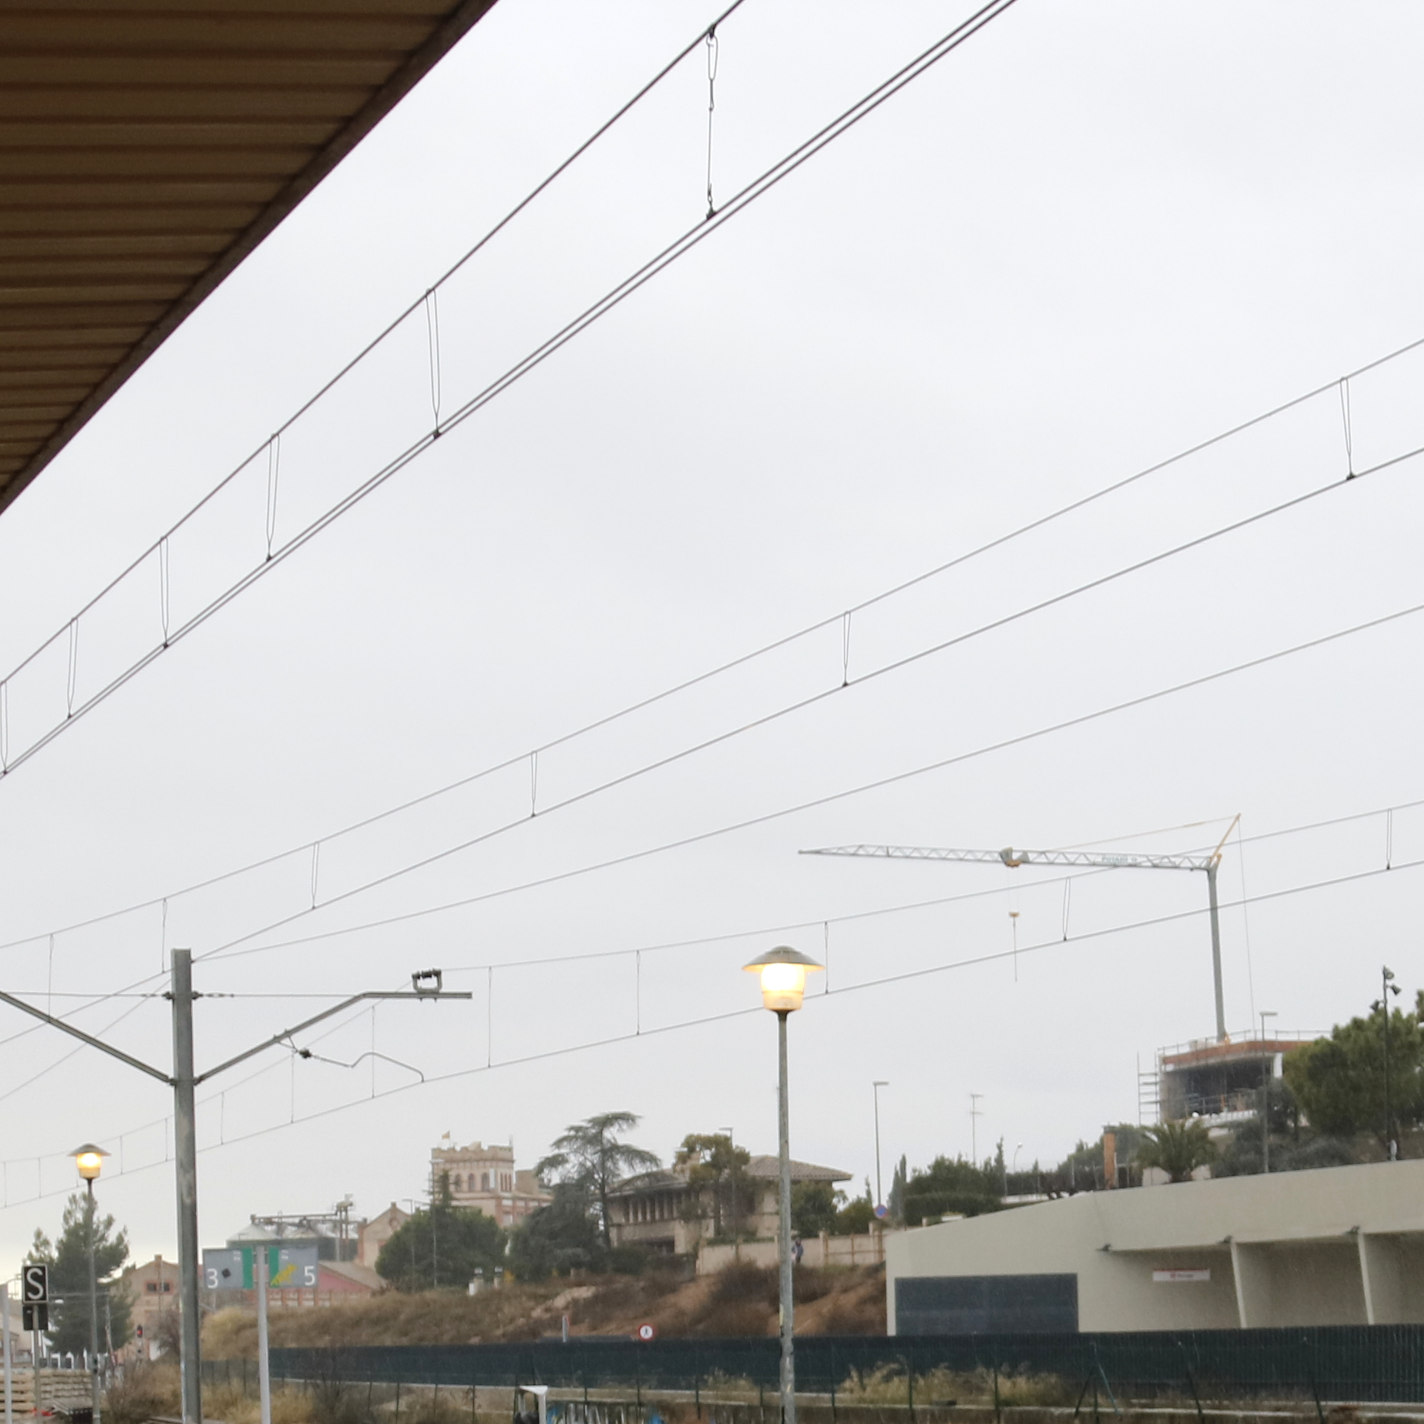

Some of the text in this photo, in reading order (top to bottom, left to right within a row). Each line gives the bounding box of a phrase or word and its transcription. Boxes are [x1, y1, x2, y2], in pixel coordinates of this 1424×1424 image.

[26, 1267, 44, 1300] S
[207, 1268, 219, 1289] 3
[304, 1265, 316, 1286] 5
